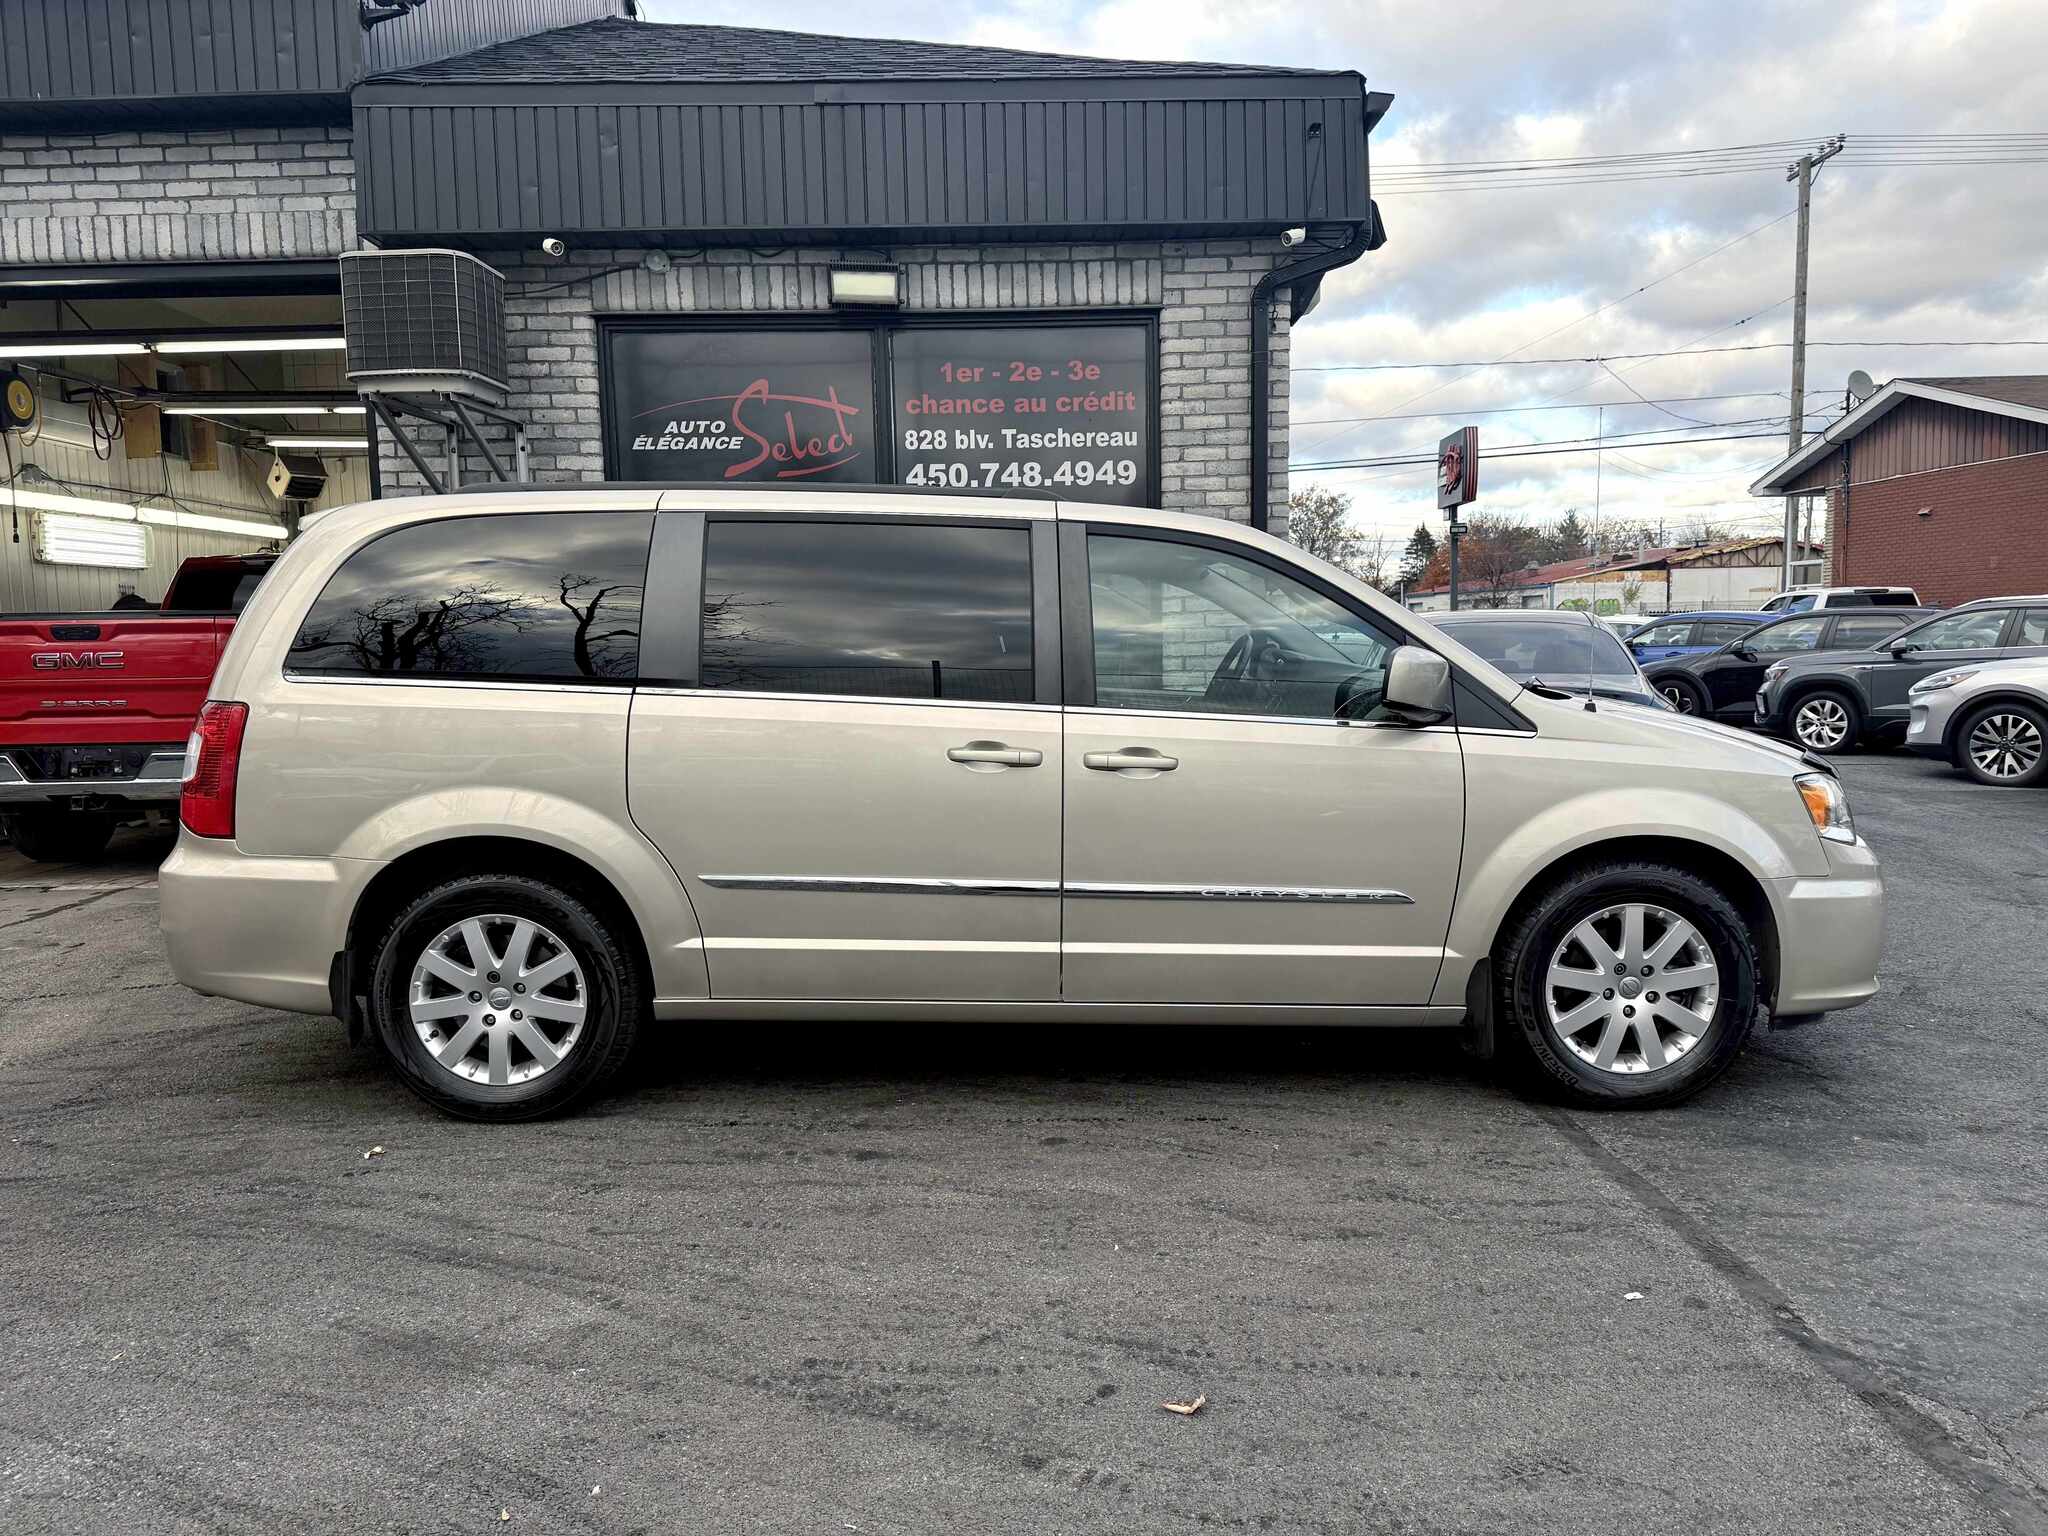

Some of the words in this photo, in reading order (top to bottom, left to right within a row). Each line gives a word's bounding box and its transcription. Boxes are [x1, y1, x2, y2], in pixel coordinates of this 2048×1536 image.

[940, 362, 984, 383] 1er
[1008, 361, 1042, 382] 2e
[1067, 360, 1101, 381] 3e
[905, 394, 1005, 415] chance
[1014, 397, 1047, 413] au
[1055, 391, 1137, 413] crédit
[664, 420, 727, 434] AUTO
[724, 378, 862, 478] Select
[632, 434, 744, 450] ÉLÉGANCE
[904, 429, 947, 450] 828
[955, 429, 994, 449] blv.
[1001, 428, 1138, 448] Taschereau
[905, 459, 1137, 487] 450.748.4949
[31, 651, 124, 669] GMC
[1200, 888, 1383, 900] CHRYSLER
